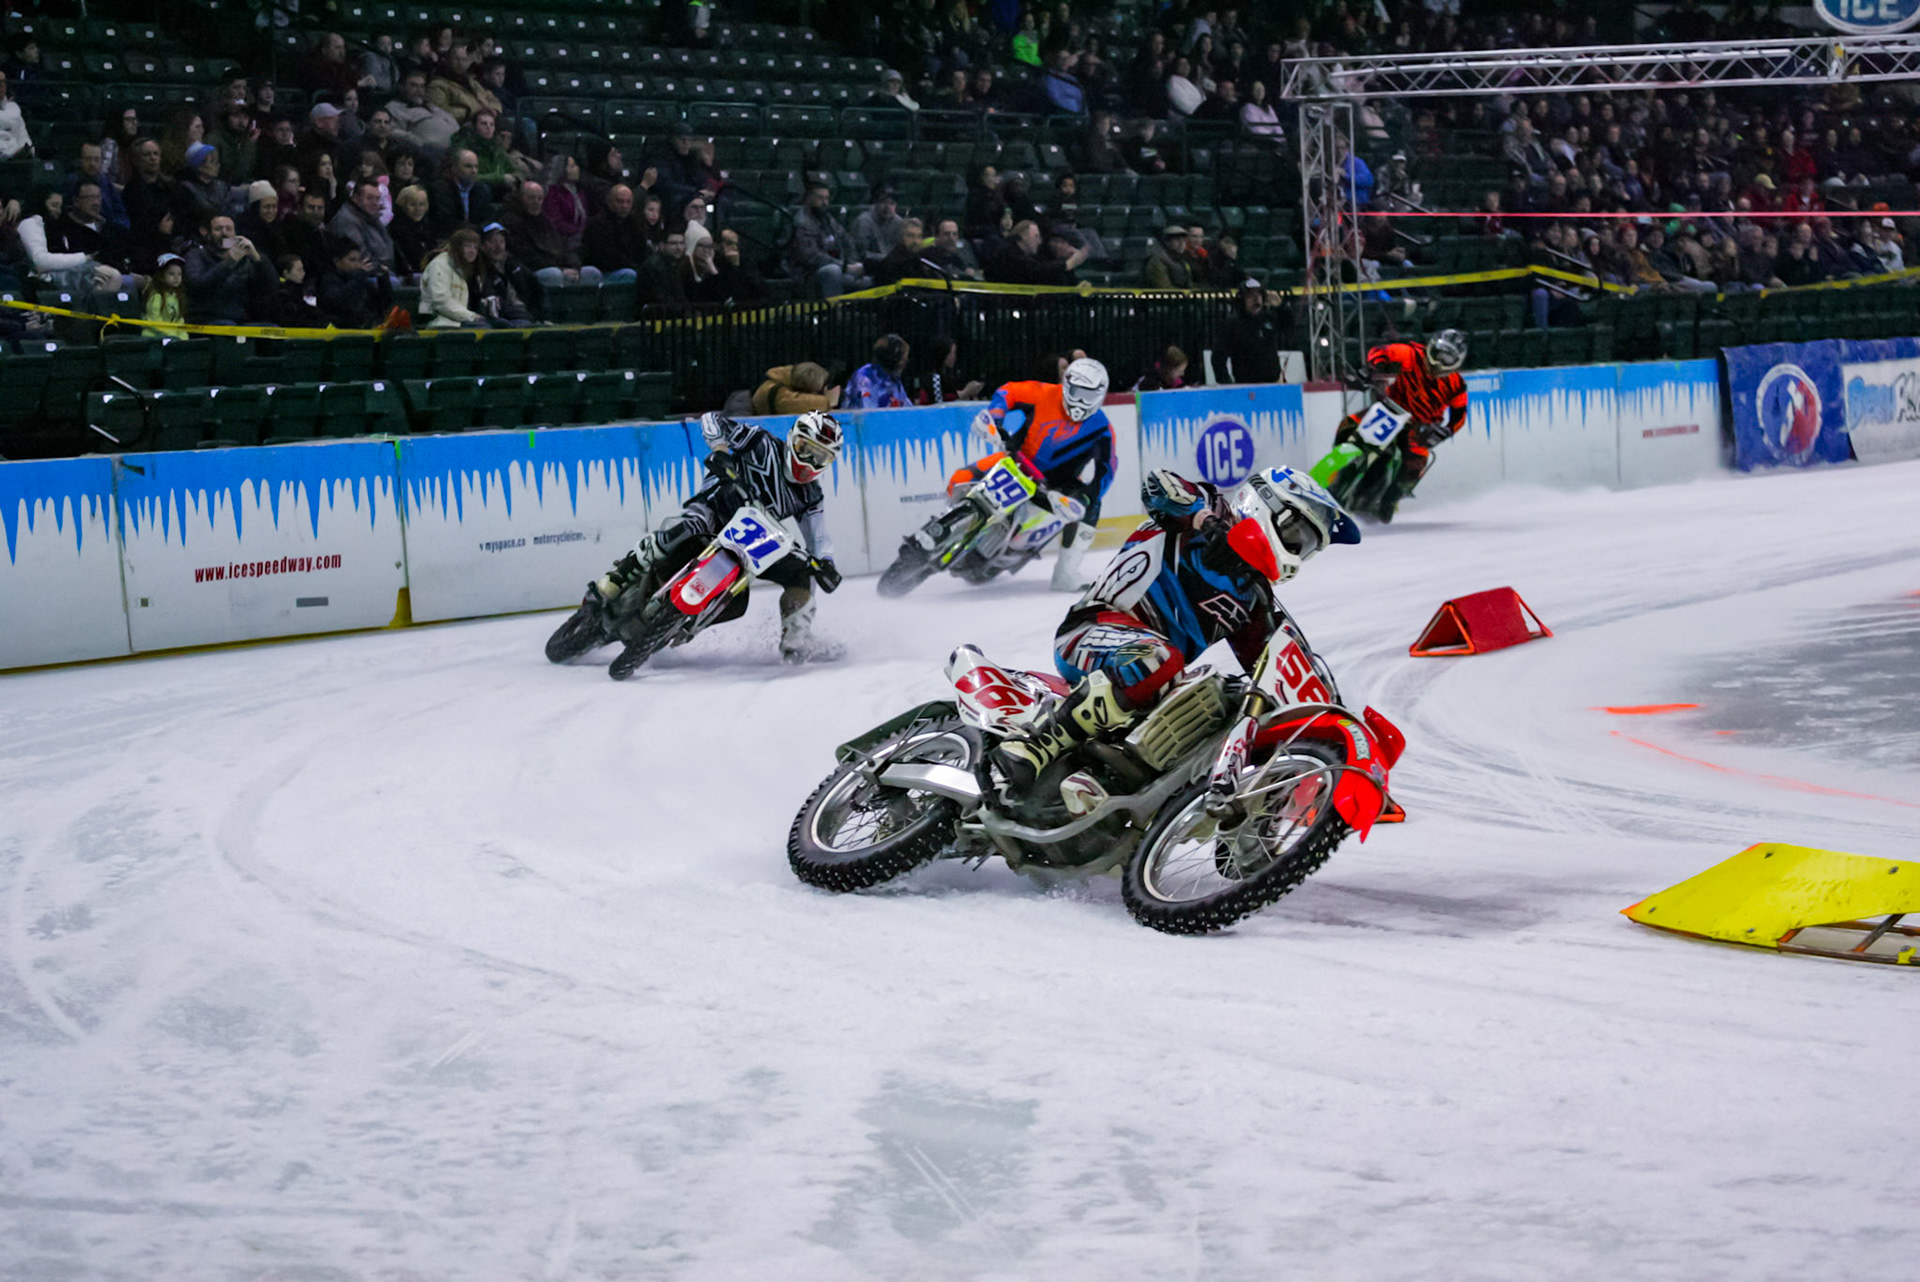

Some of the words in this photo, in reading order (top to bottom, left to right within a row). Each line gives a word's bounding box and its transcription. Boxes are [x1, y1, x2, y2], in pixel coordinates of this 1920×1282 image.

[1205, 429, 1247, 482] ICE
[985, 467, 1028, 508] 99
[724, 517, 781, 569] 31
[194, 554, 342, 583] www.icespeedway.com
